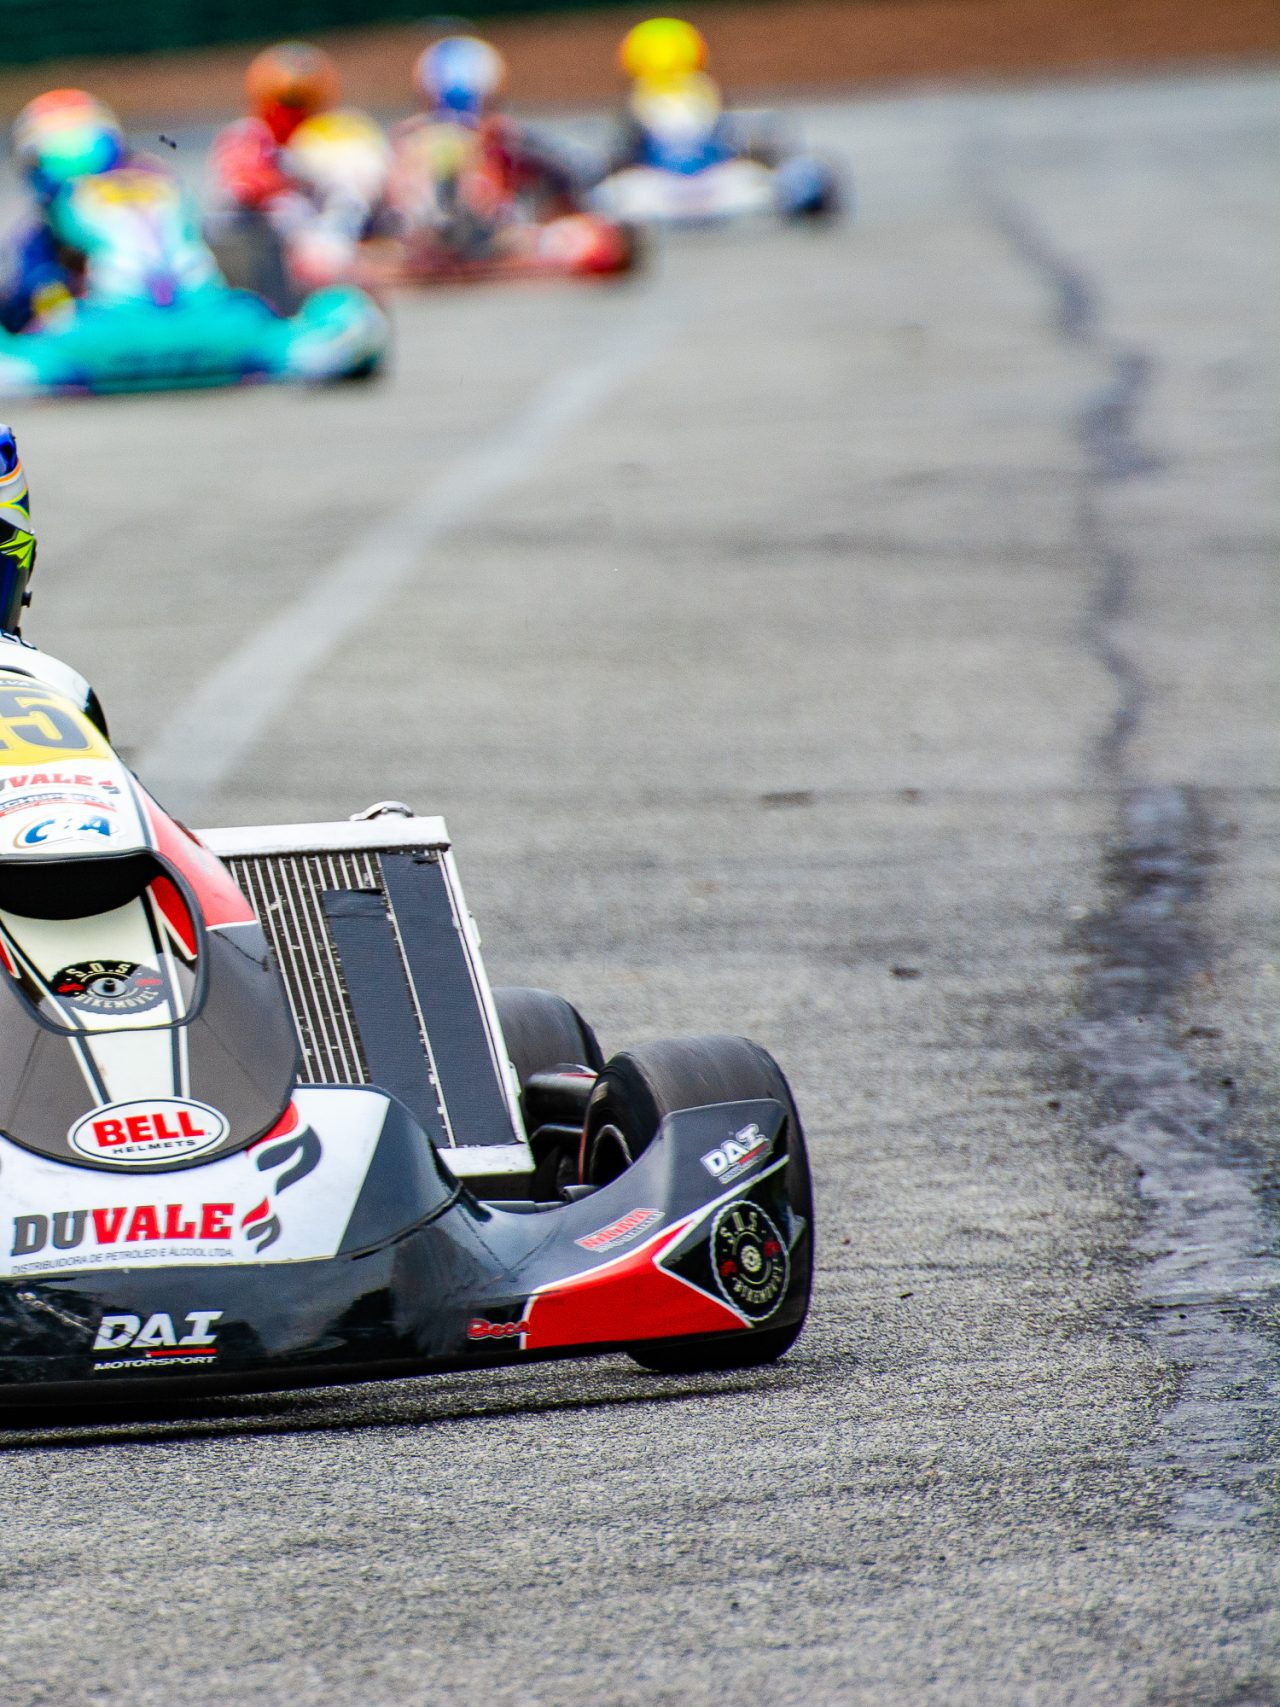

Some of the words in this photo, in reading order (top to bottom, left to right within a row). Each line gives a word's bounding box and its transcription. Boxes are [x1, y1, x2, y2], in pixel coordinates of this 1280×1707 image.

[92, 1111, 205, 1147] BELL
[113, 1140, 196, 1154] HELMETS
[701, 1125, 763, 1175] DAI
[10, 1203, 235, 1257] DUVALE
[93, 1311, 224, 1350] DAI
[94, 1356, 217, 1371] MOTORSPORT
